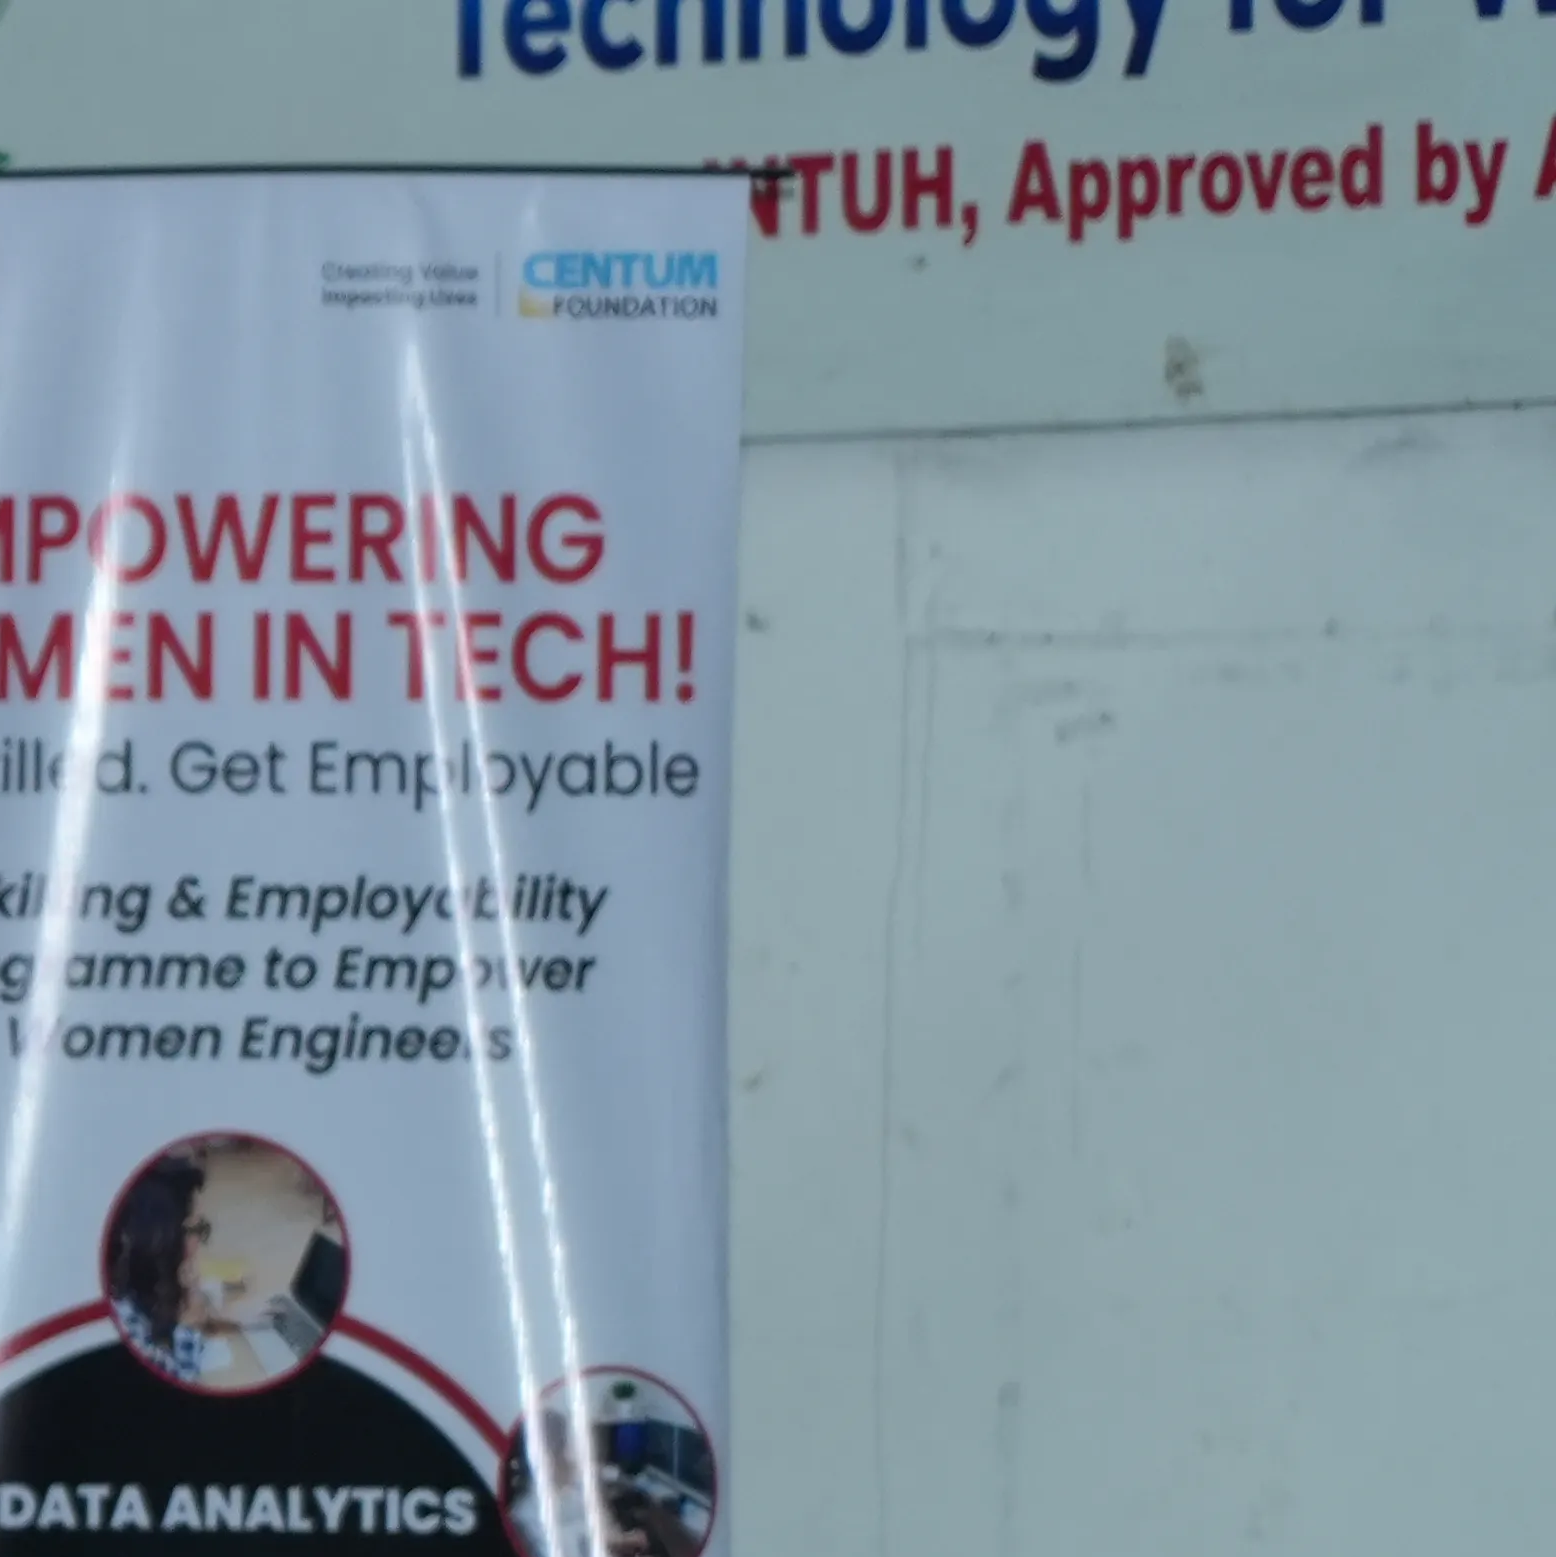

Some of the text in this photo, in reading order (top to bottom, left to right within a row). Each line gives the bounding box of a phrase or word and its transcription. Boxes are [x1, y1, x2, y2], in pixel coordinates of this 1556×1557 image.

[1006, 122, 1383, 243] Approved
[1415, 118, 1509, 226] by
[522, 250, 719, 289] CENTUM
[552, 295, 719, 320] FOUNDATION
[254, 611, 352, 702] IN
[387, 611, 696, 703] TECH!
[170, 740, 286, 795] Get
[310, 739, 700, 813] Employable
[167, 874, 205, 920] &
[264, 946, 318, 990] to
[238, 1012, 512, 1075] Enginees
[160, 1484, 479, 1536] ANALYTICS
